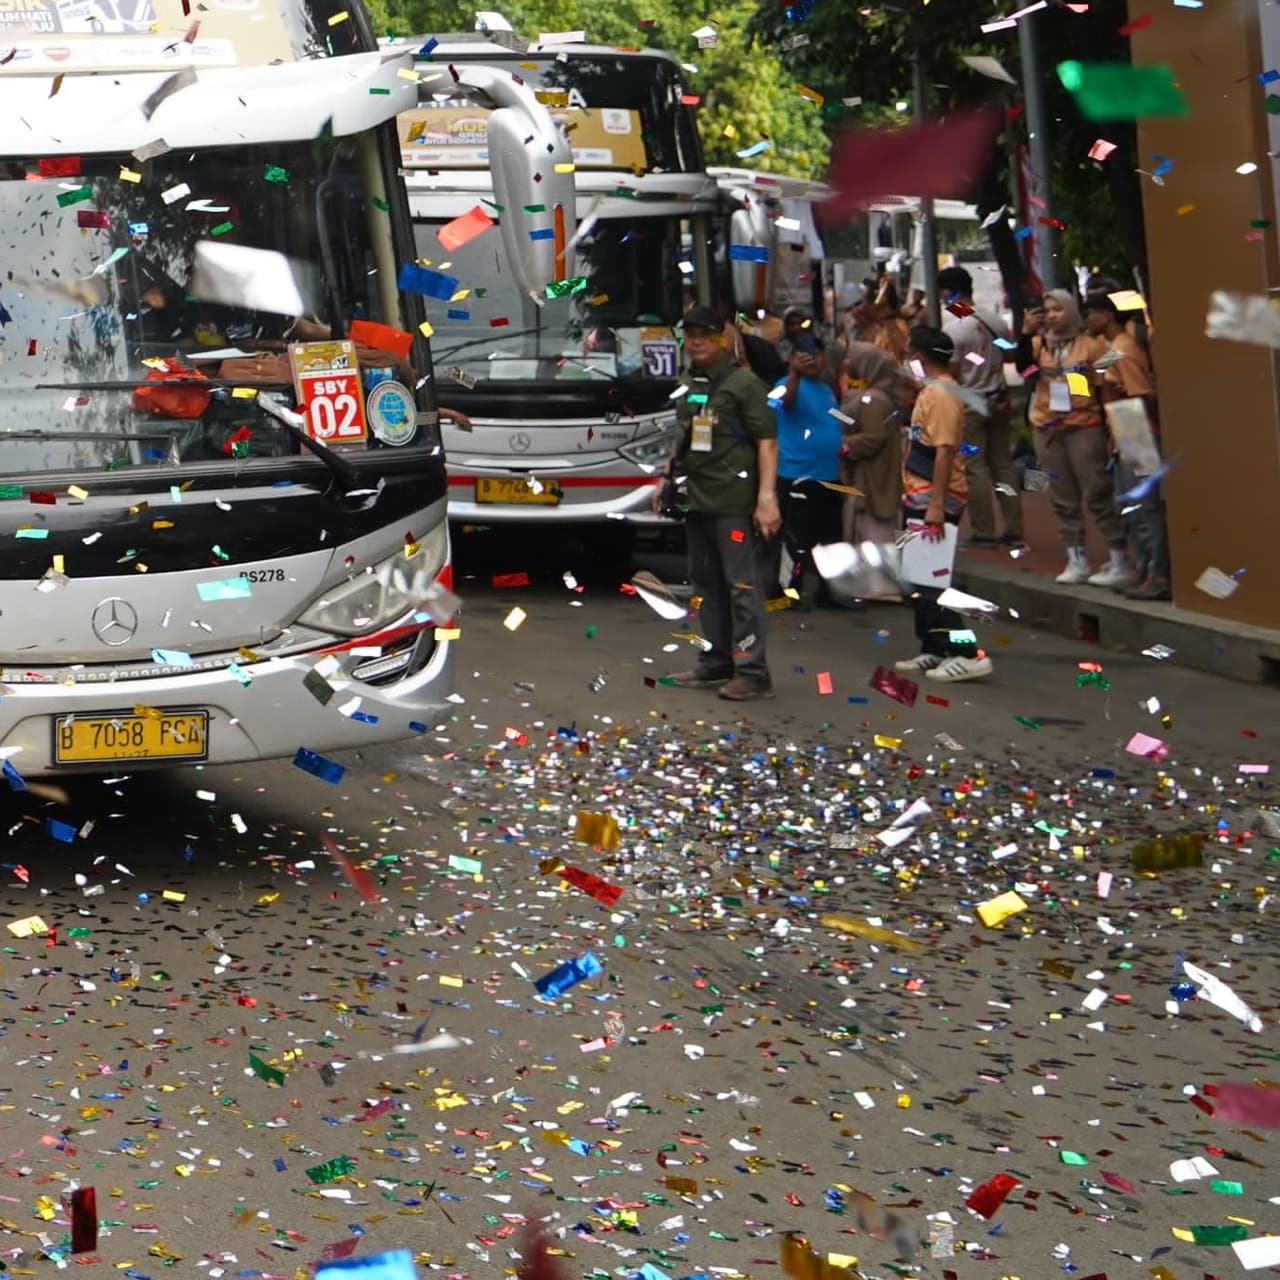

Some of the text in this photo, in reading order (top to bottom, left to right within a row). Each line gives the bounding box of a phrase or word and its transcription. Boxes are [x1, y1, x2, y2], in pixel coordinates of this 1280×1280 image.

[313, 380, 348, 395] SBY
[310, 394, 362, 438] 02
[61, 724, 74, 750] B
[90, 720, 144, 749] 7058
